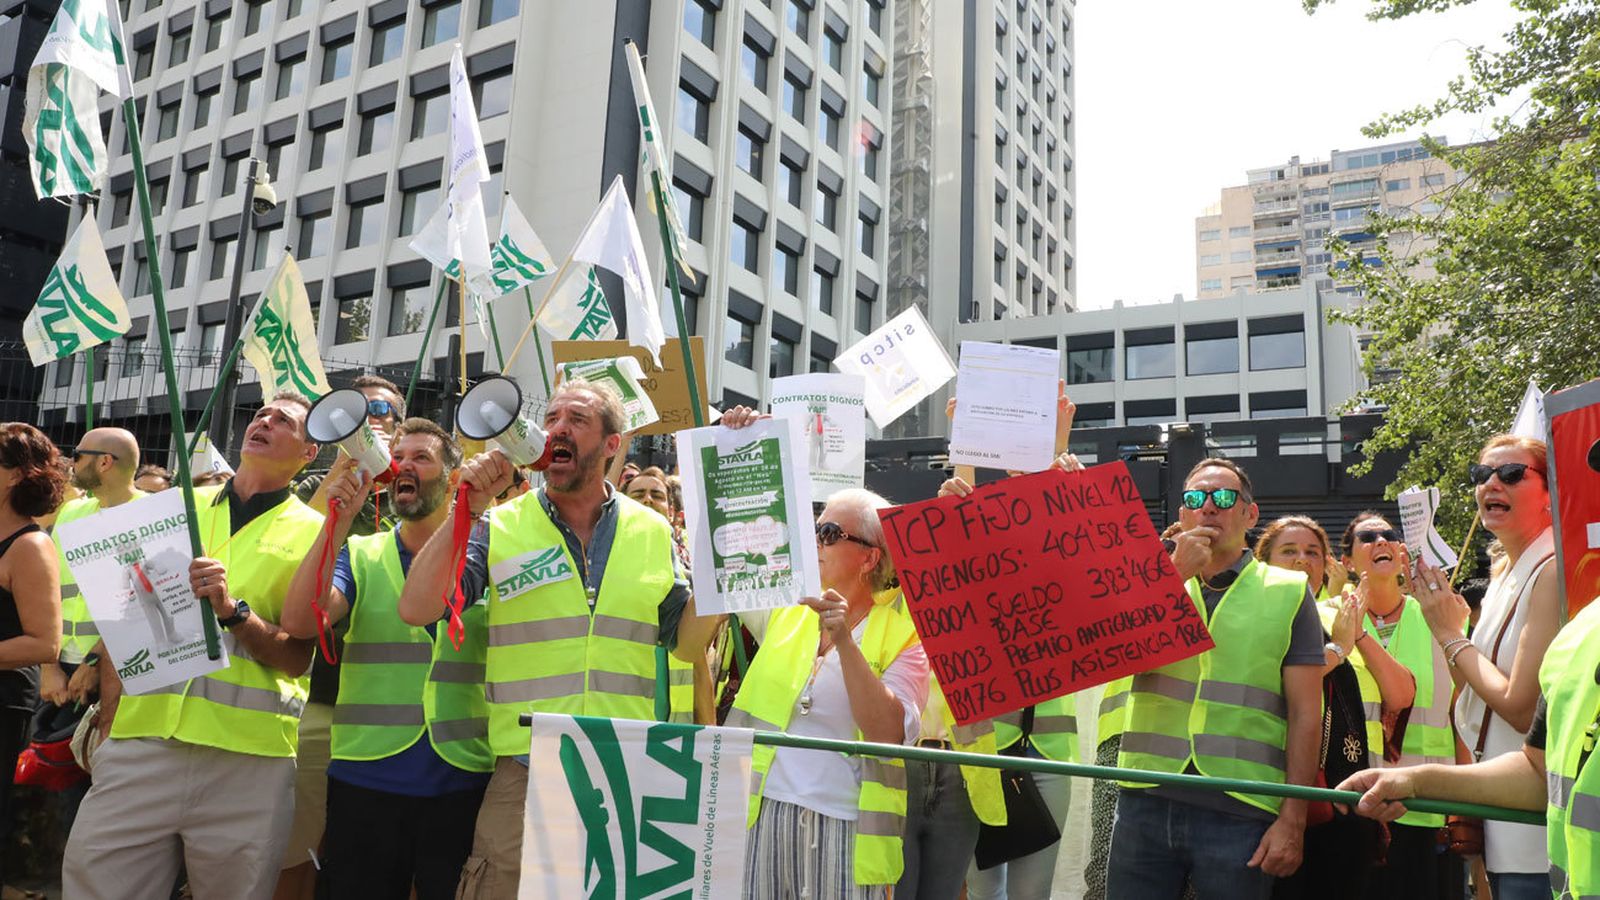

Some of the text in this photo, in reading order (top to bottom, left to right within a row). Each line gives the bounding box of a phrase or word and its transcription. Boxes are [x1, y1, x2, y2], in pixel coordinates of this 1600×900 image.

[773, 395, 864, 406] CONTRATOS DIGNOS
[718, 451, 763, 466] STAVLA
[882, 507, 945, 559] TCP
[1110, 474, 1141, 505] 12
[65, 529, 138, 562] ONTRATOS
[496, 562, 573, 598] STAVLA
[1014, 667, 1063, 699] PLUS
[710, 733, 722, 769] Aéreas
[705, 806, 716, 820] de
[703, 822, 715, 851] Vuelo
[702, 851, 713, 865] de
